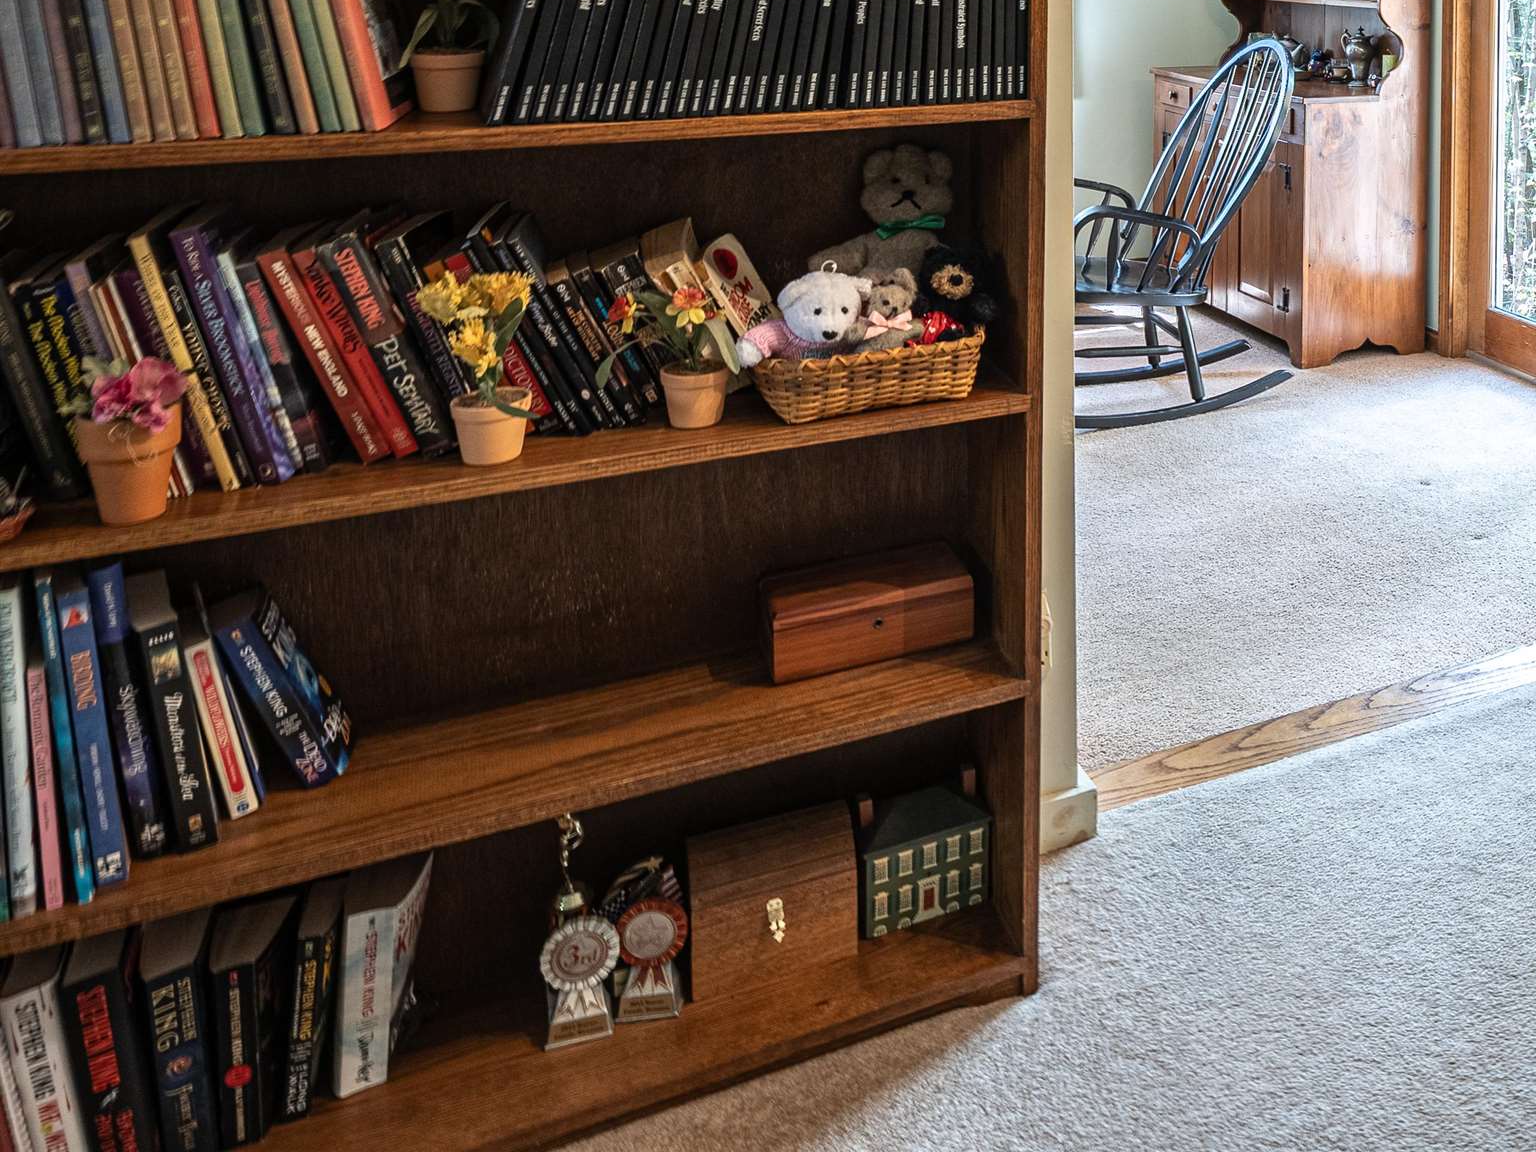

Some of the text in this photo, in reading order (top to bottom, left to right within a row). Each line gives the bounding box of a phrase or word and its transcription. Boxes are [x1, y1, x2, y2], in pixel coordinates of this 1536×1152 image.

[752, 25, 763, 41] Sects
[755, 6, 766, 26] Secret
[856, 1, 867, 24] Peoples
[956, 23, 965, 48] Symbols
[336, 248, 369, 299] STEPHEN
[357, 297, 384, 329] KING
[304, 324, 324, 349] NEW
[318, 349, 348, 397] ENGLAND
[437, 354, 464, 397] REGISTE
[240, 645, 273, 692] STEPHEN
[265, 688, 288, 718] KING
[363, 931, 378, 984] STEPHEN
[563, 944, 597, 967] 3rd
[151, 984, 179, 1052] KING
[299, 960, 317, 1041] STEPHEN KING
[361, 986, 375, 1018] KING
[14, 1001, 46, 1063] STEPHEN
[30, 1065, 55, 1099] KING
